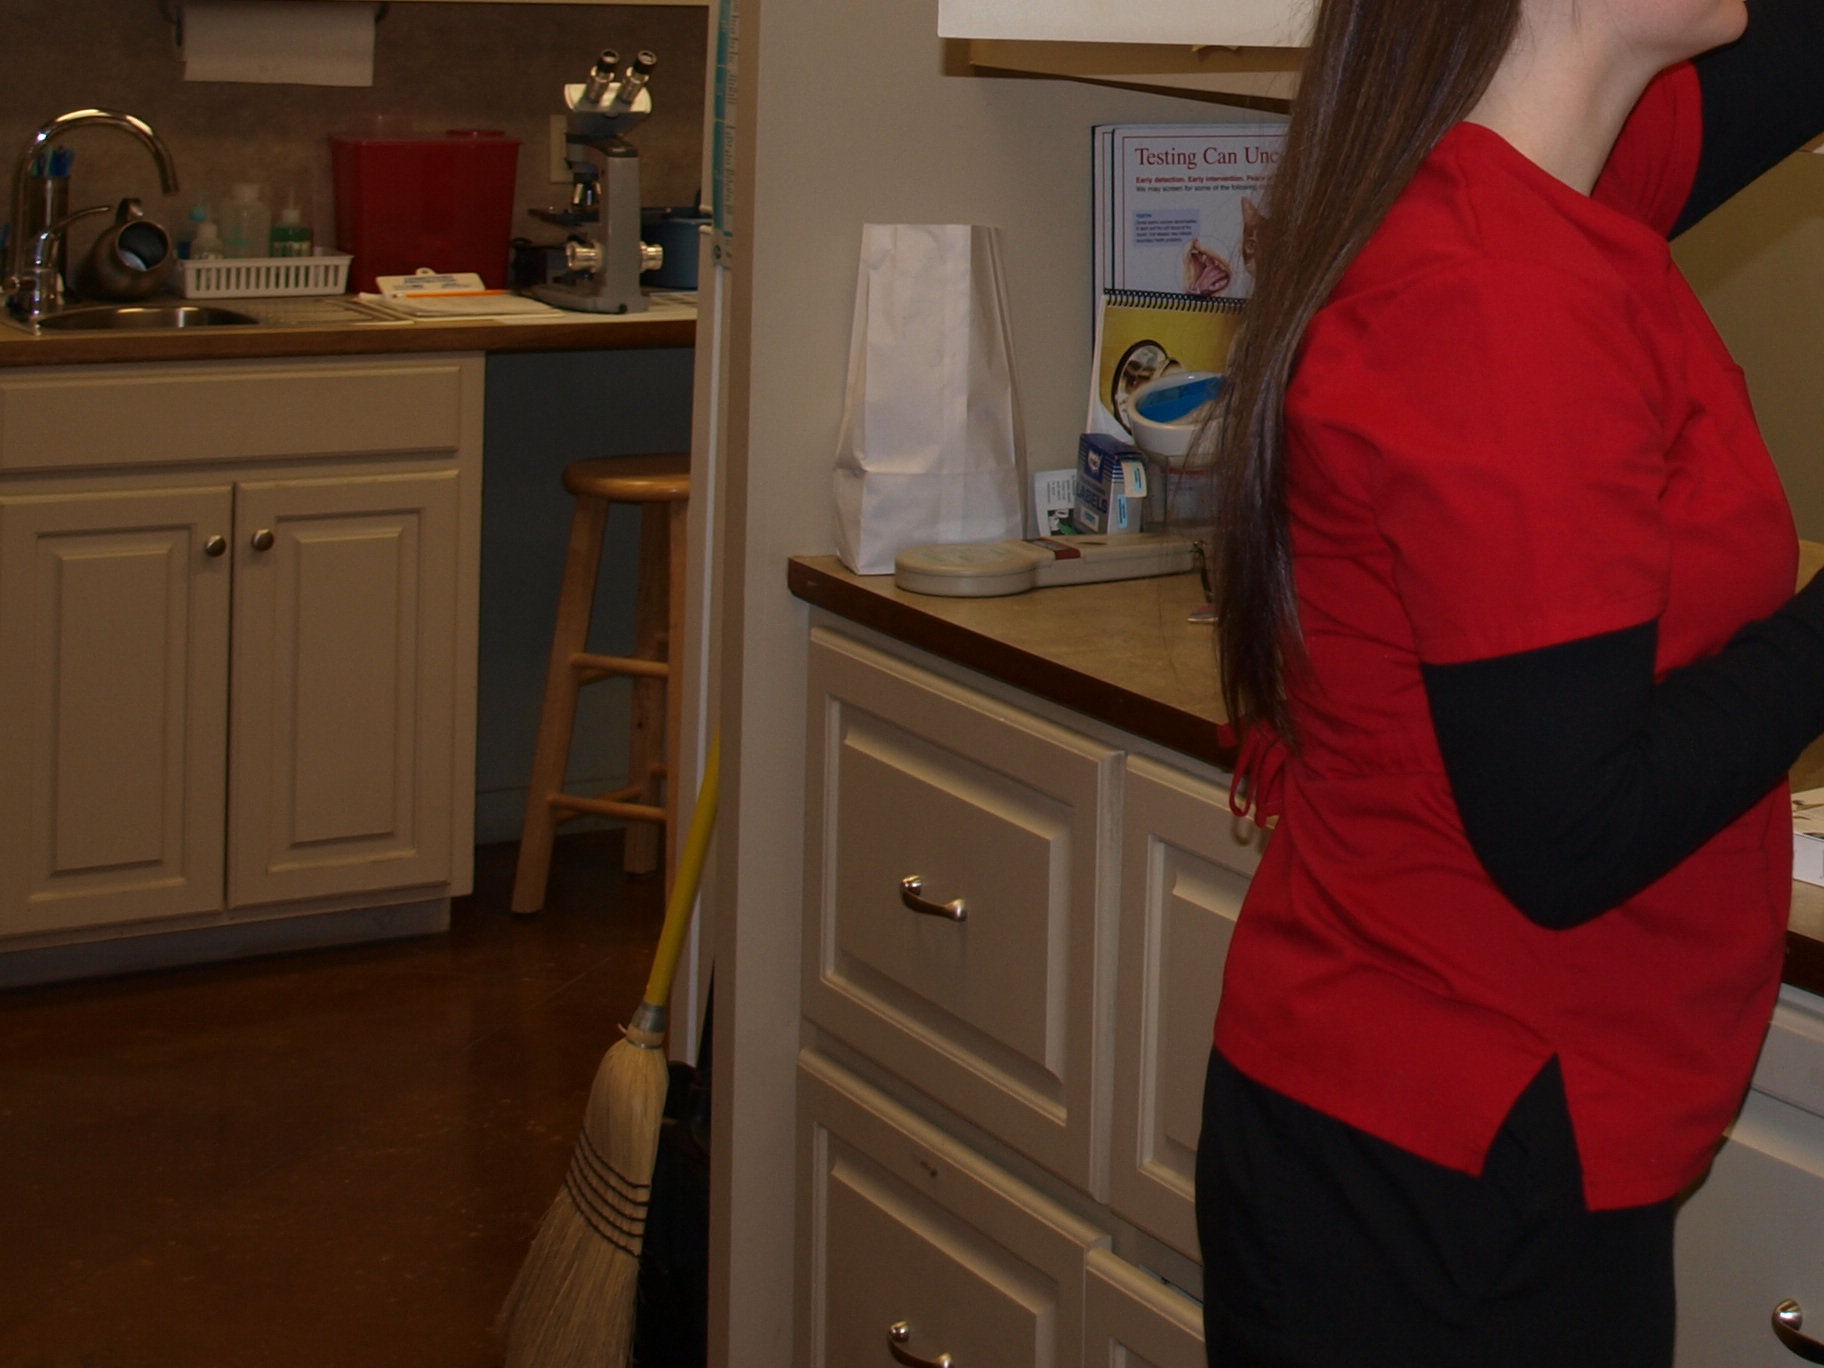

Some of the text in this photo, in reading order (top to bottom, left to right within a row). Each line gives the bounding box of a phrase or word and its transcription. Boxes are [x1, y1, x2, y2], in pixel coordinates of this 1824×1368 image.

[1135, 146, 1280, 170] Testing Can Unc
[1136, 176, 1153, 184] Early
[1154, 175, 1186, 184] detection.
[1187, 175, 1204, 184] Early
[1205, 174, 1245, 183] intervention.
[1136, 185, 1147, 193] We
[1147, 186, 1161, 194] may
[1162, 185, 1183, 193] screen
[1184, 184, 1193, 192] for
[1219, 184, 1230, 192] the
[1231, 183, 1258, 193] following
[1077, 488, 1109, 516] LABELS
